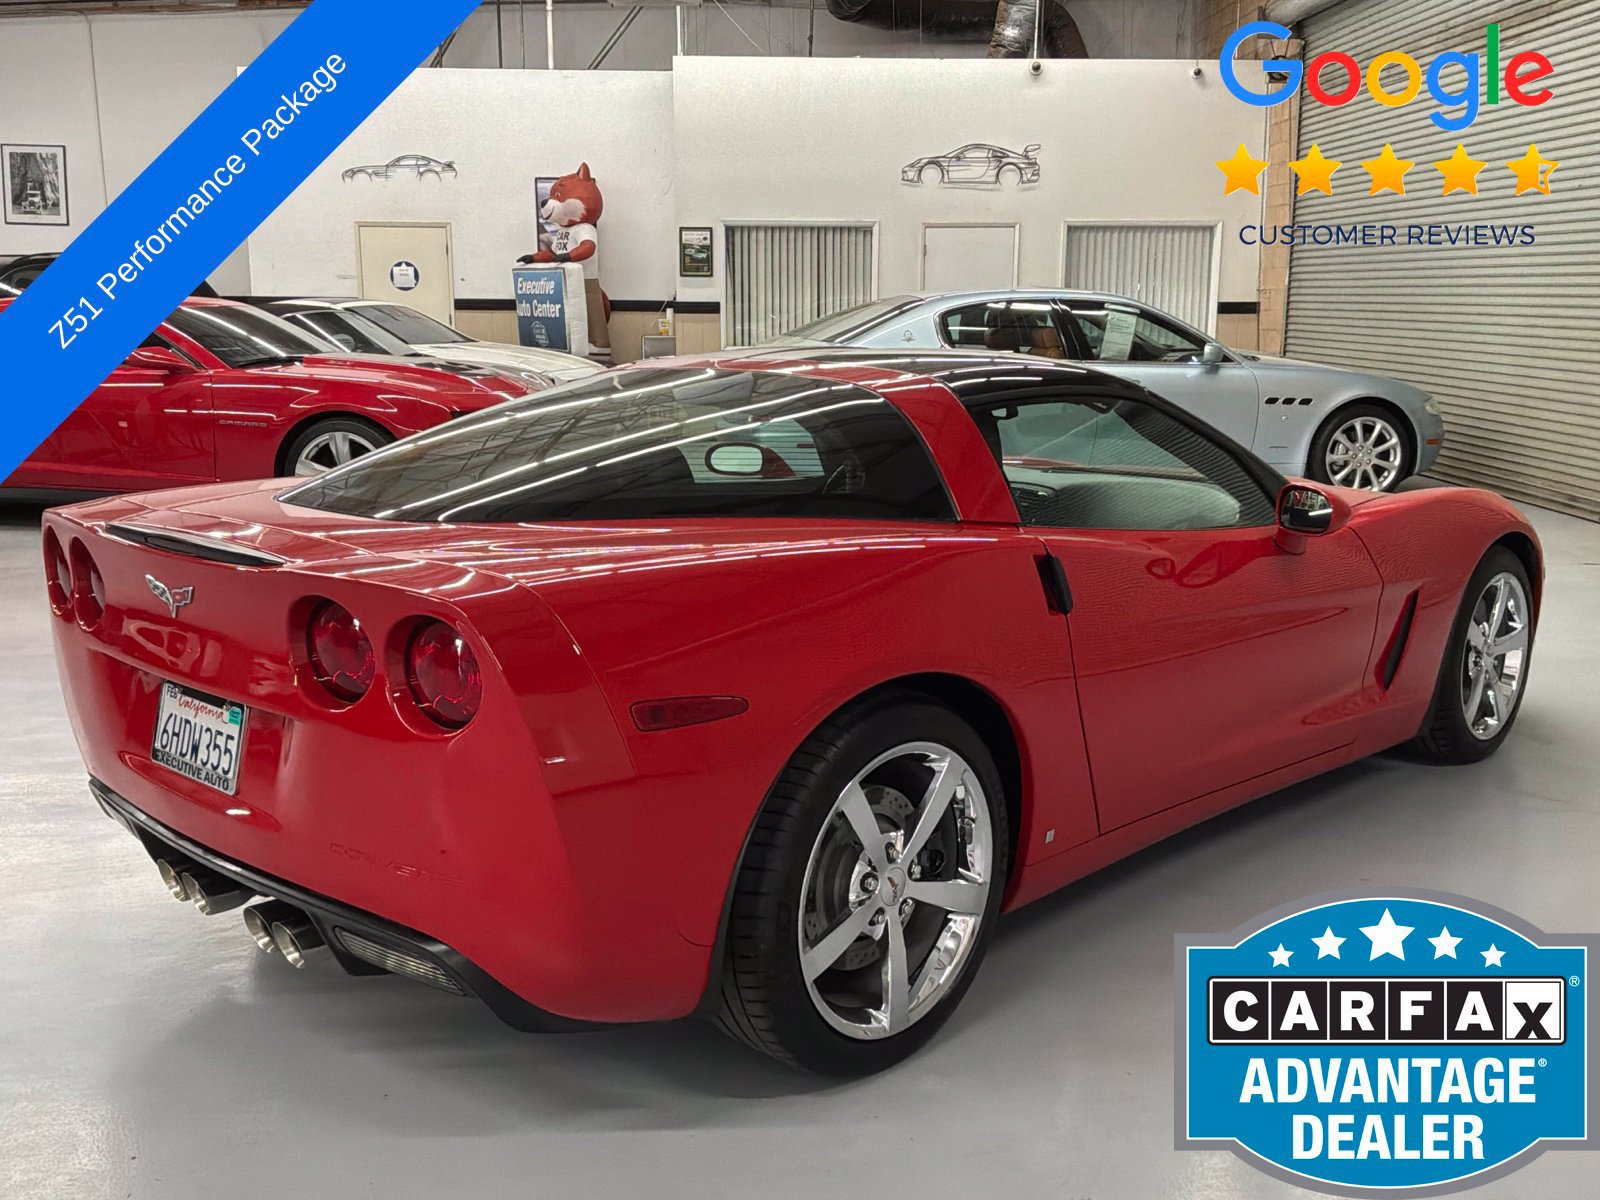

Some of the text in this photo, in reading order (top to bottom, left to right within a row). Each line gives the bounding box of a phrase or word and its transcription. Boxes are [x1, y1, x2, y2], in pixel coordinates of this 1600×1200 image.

[517, 276, 555, 295] Executive
[517, 299, 562, 318] uto Center
[177, 693, 229, 725] California
[159, 712, 236, 777] 6HDW355
[153, 750, 231, 792] EXECUTIVE AUTO
